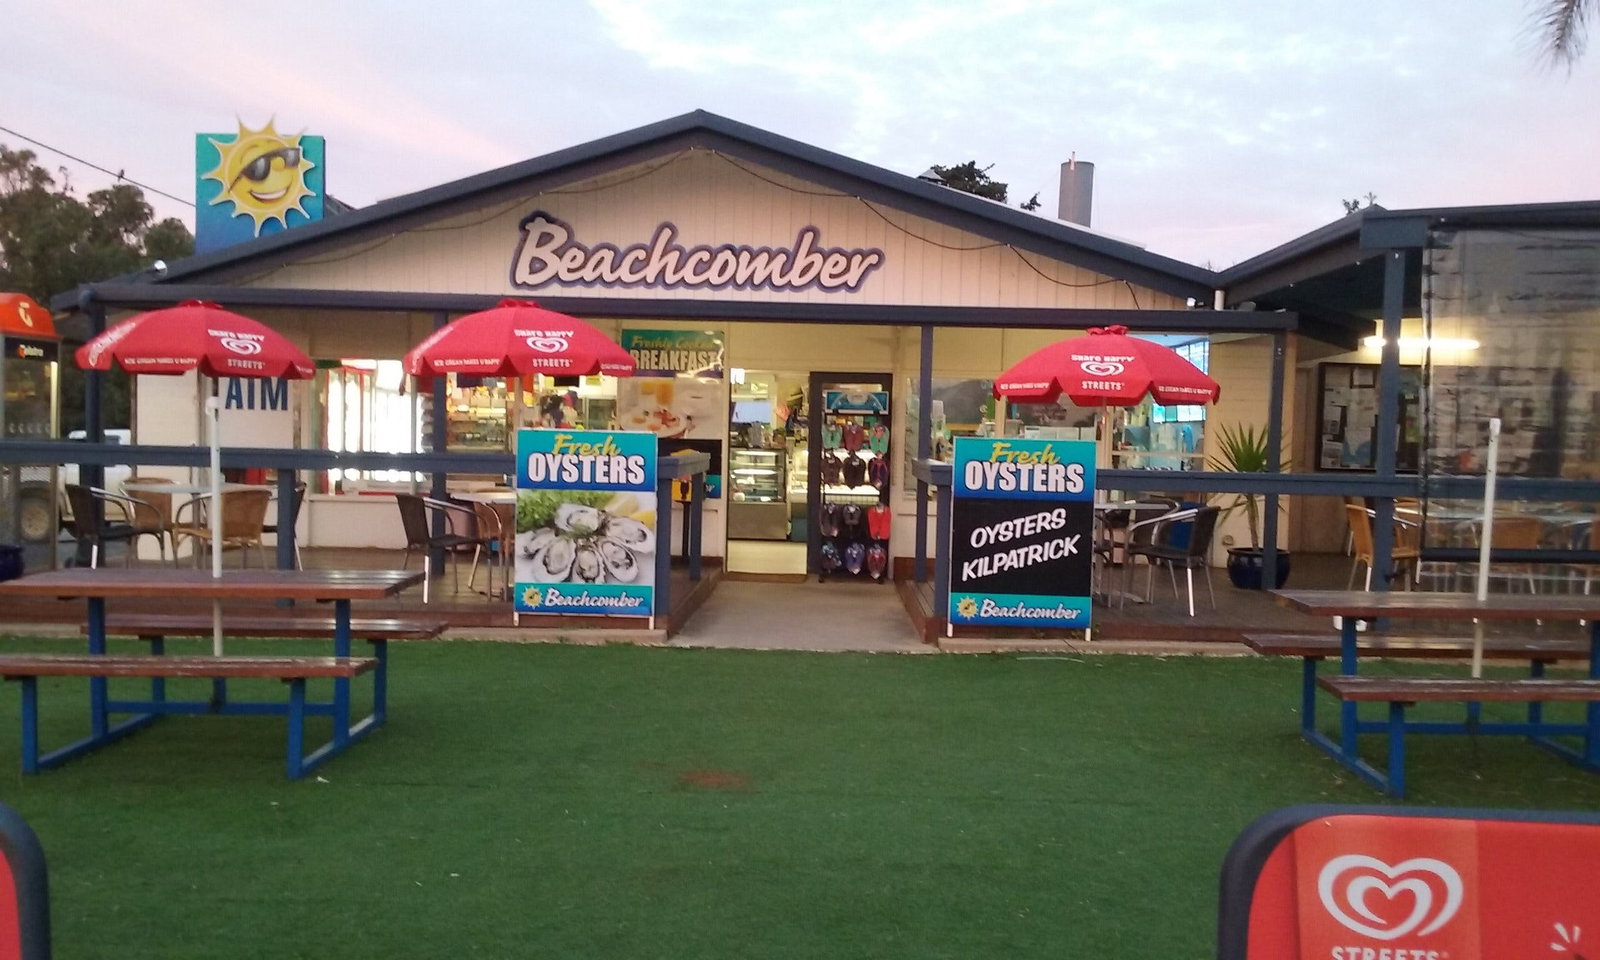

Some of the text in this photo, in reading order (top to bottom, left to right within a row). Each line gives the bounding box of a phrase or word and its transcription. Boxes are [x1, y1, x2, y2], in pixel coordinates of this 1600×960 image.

[513, 215, 882, 289] Beachcomber
[227, 358, 263, 370] STREETS
[532, 358, 571, 368] STREETS
[629, 349, 718, 371] BREAKFAST
[1081, 380, 1122, 391] STREETS
[552, 433, 622, 457] Fresh
[989, 442, 1060, 465] Fresh
[527, 452, 645, 485] OYSTERS
[964, 460, 1085, 494] OYSTERS
[970, 508, 1067, 549] OYSTERS
[961, 534, 1081, 582] KILPATRICK
[544, 586, 644, 608] Beachcomber
[979, 598, 1081, 621] Beachcomber
